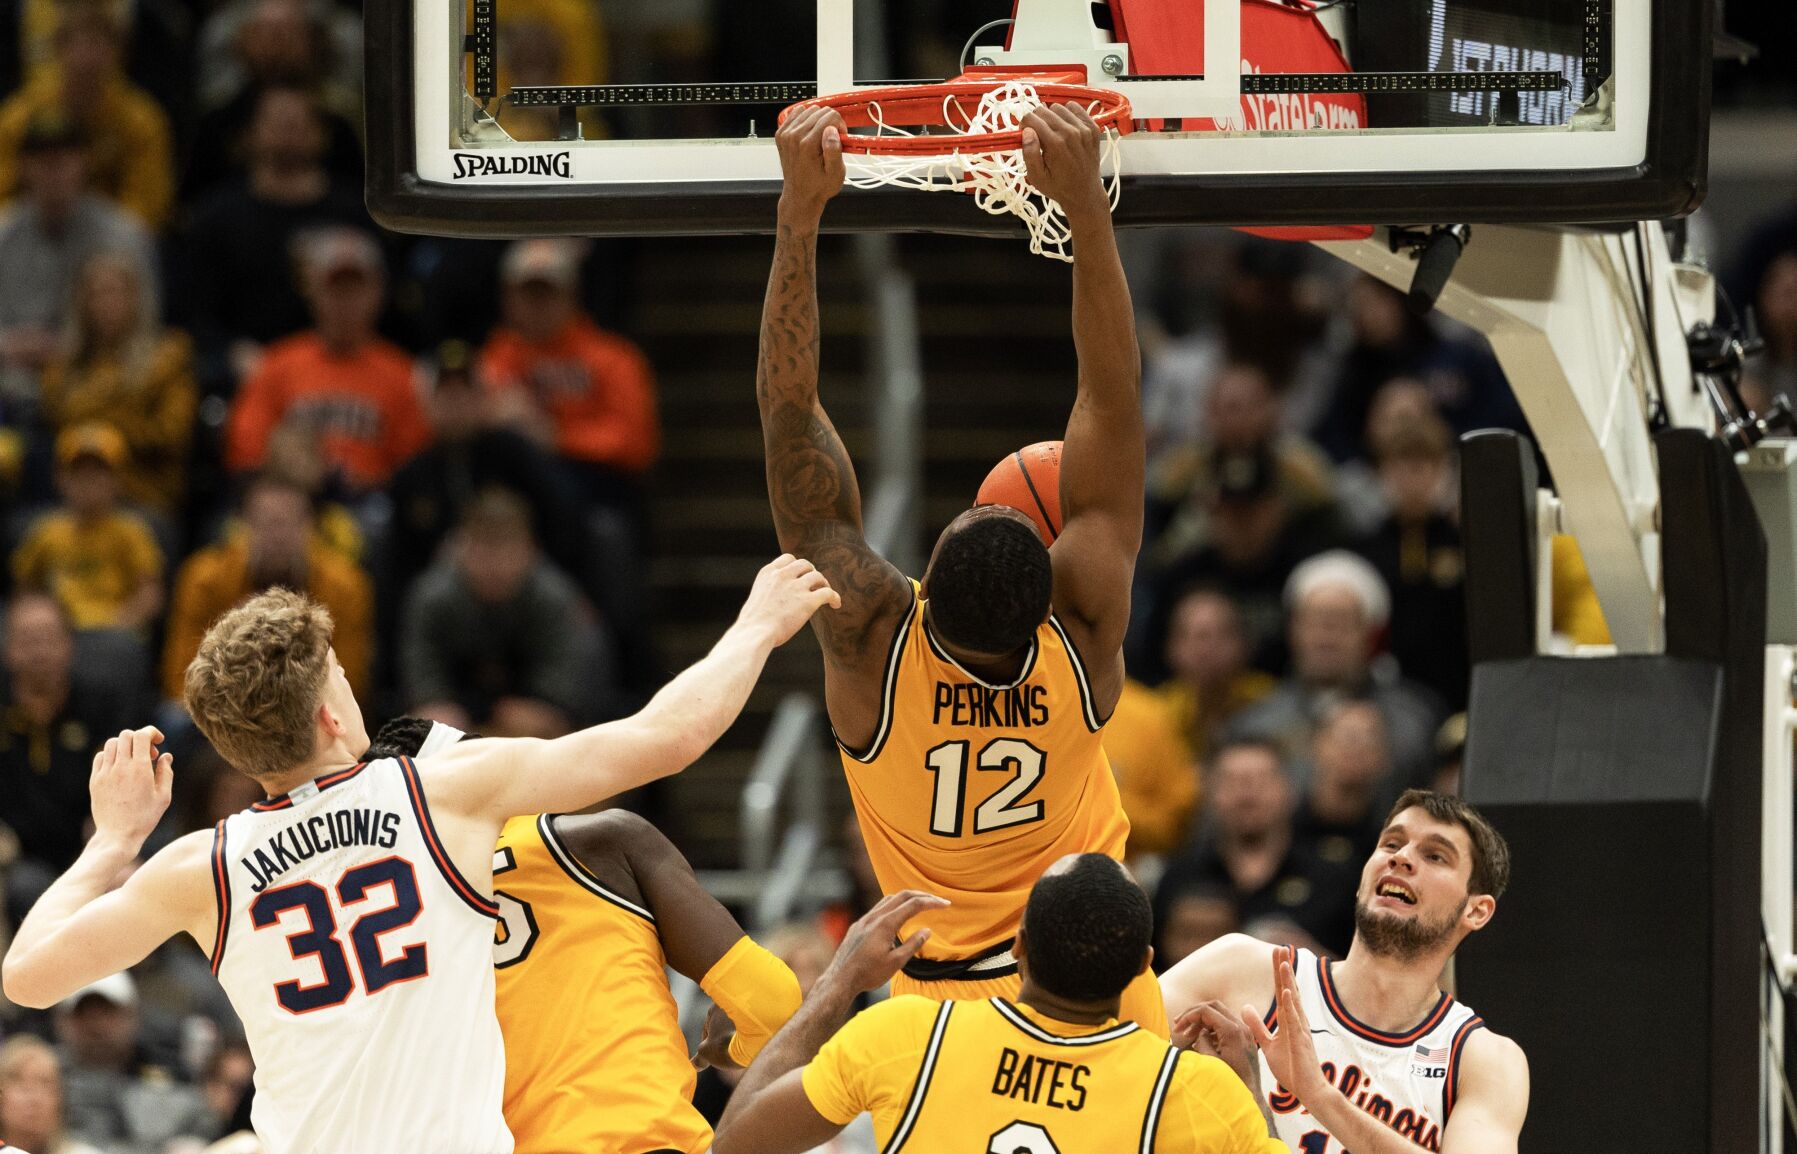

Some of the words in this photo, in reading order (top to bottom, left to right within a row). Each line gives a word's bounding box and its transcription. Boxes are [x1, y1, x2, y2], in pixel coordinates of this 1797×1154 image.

[453, 151, 570, 179] SPALDING
[933, 681, 1049, 728] PERKINS
[925, 737, 1047, 838] 12
[241, 809, 401, 893] JAKUCIONIS
[249, 855, 429, 1015] 32
[991, 1047, 1091, 1112] BATES
